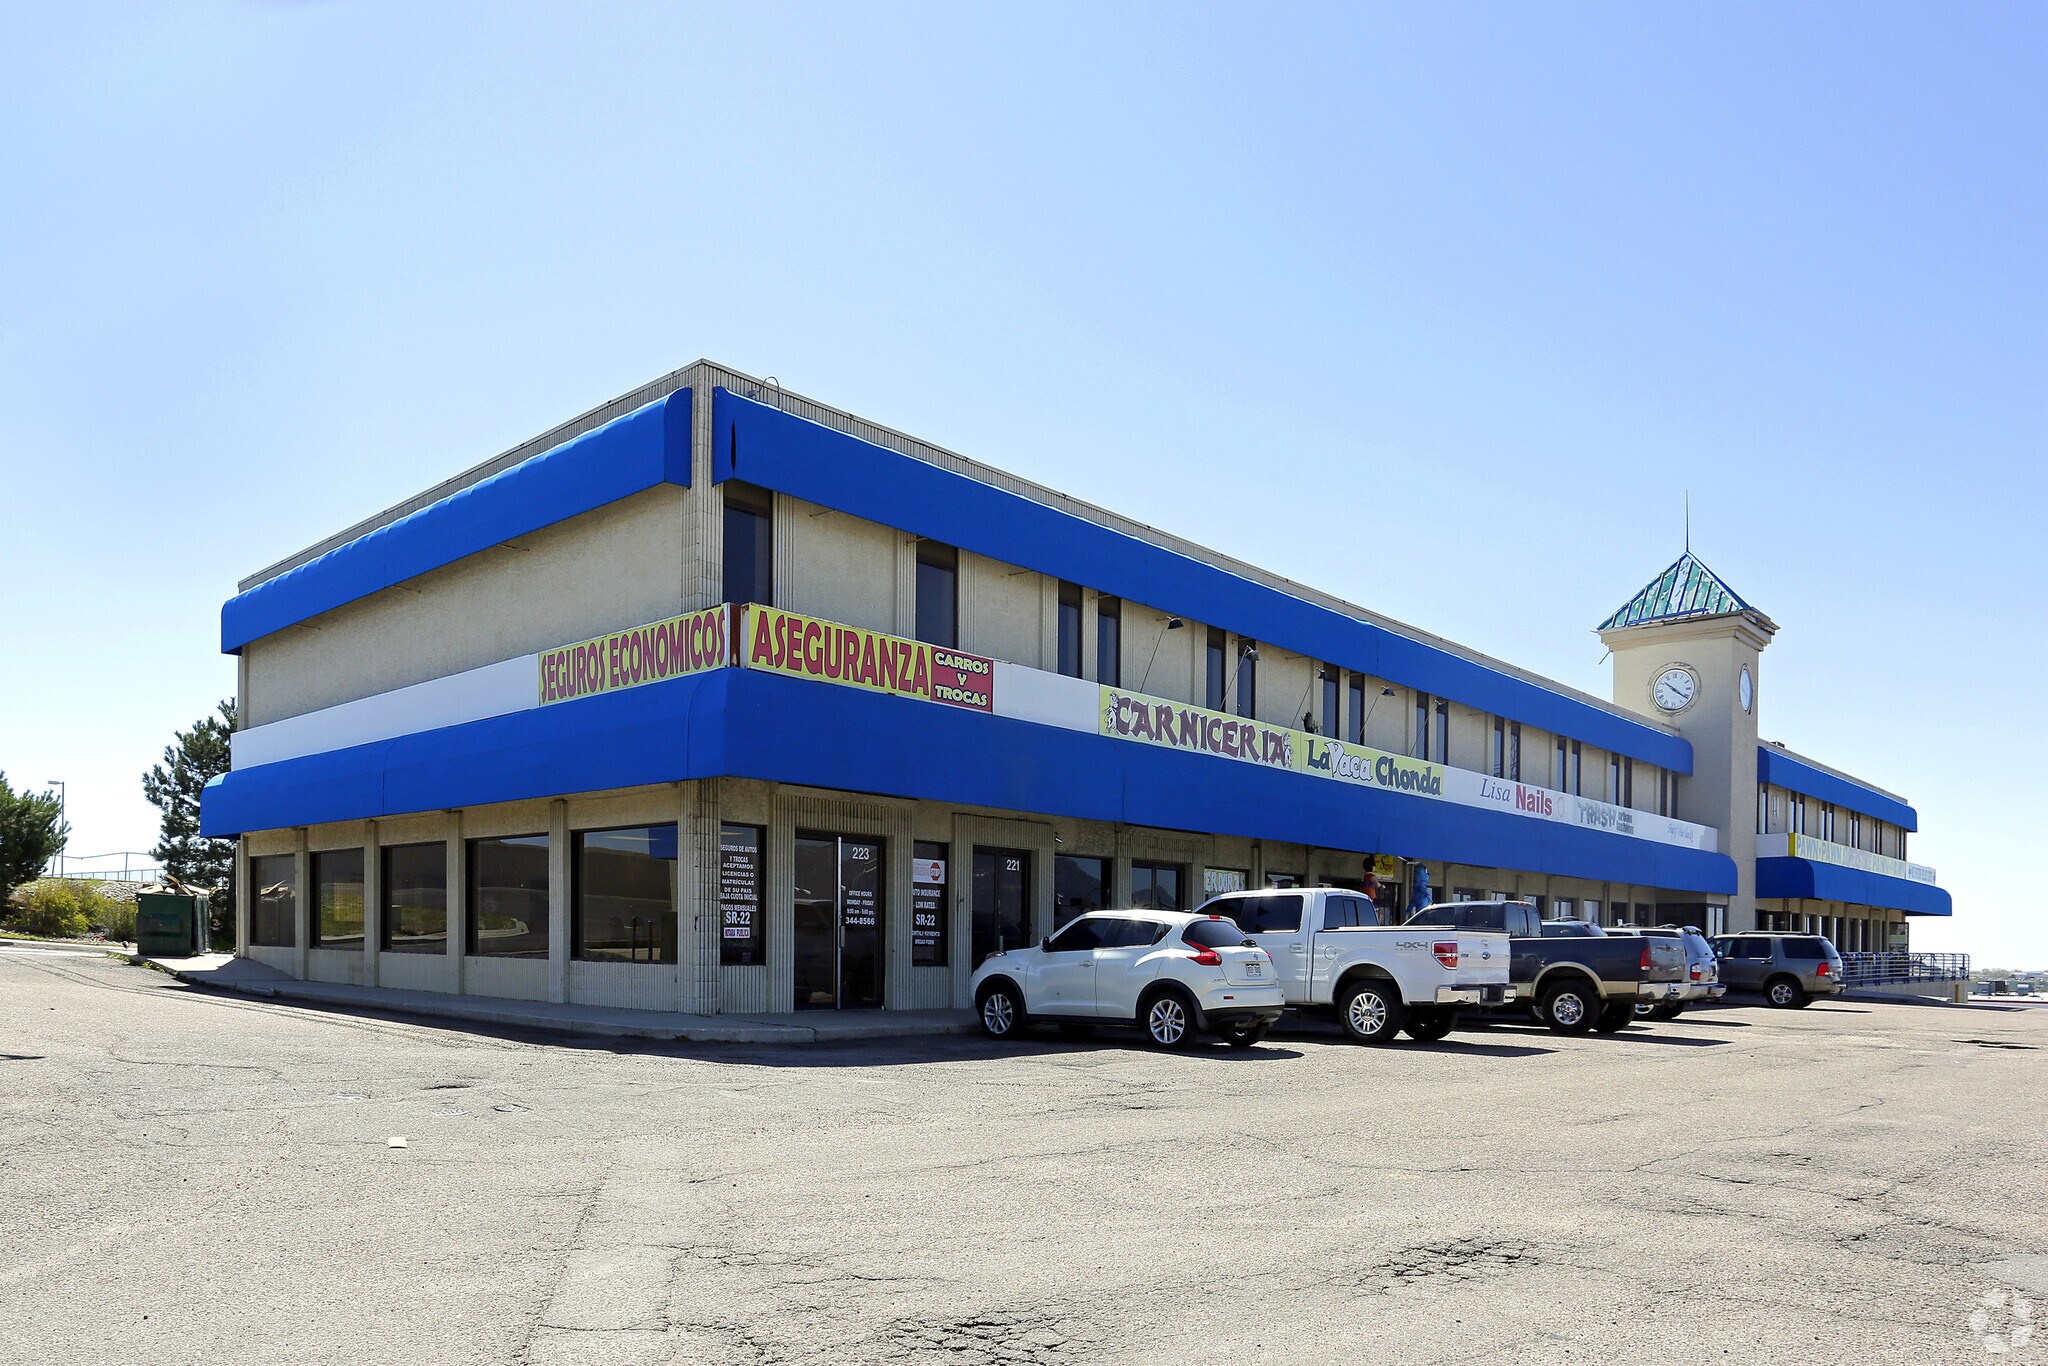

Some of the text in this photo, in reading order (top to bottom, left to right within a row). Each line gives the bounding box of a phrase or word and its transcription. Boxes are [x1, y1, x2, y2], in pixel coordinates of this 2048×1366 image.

[541, 608, 726, 703] SEGUROS ECONOMICOS
[752, 610, 929, 696] ASEGURANZA
[934, 652, 990, 676] CARROS
[956, 673, 968, 687] Y
[934, 684, 988, 708] TROCAS
[1116, 696, 1287, 768] CARNICERIA
[1305, 739, 1442, 796] La Vaca Chonda
[1480, 778, 1553, 816] Lisa Nails
[1577, 801, 1617, 828] TRASH
[1618, 811, 1633, 823] urban
[1616, 820, 1634, 835] fashion
[720, 844, 738, 852] SEGUROS
[852, 847, 870, 860] 223
[1006, 859, 1020, 871] 221
[1204, 871, 1246, 892] ERDURAS
[912, 888, 941, 897] UTO INSURANCE
[916, 901, 924, 909] LOW
[725, 911, 751, 924] SR-22
[916, 913, 936, 926] SR-22
